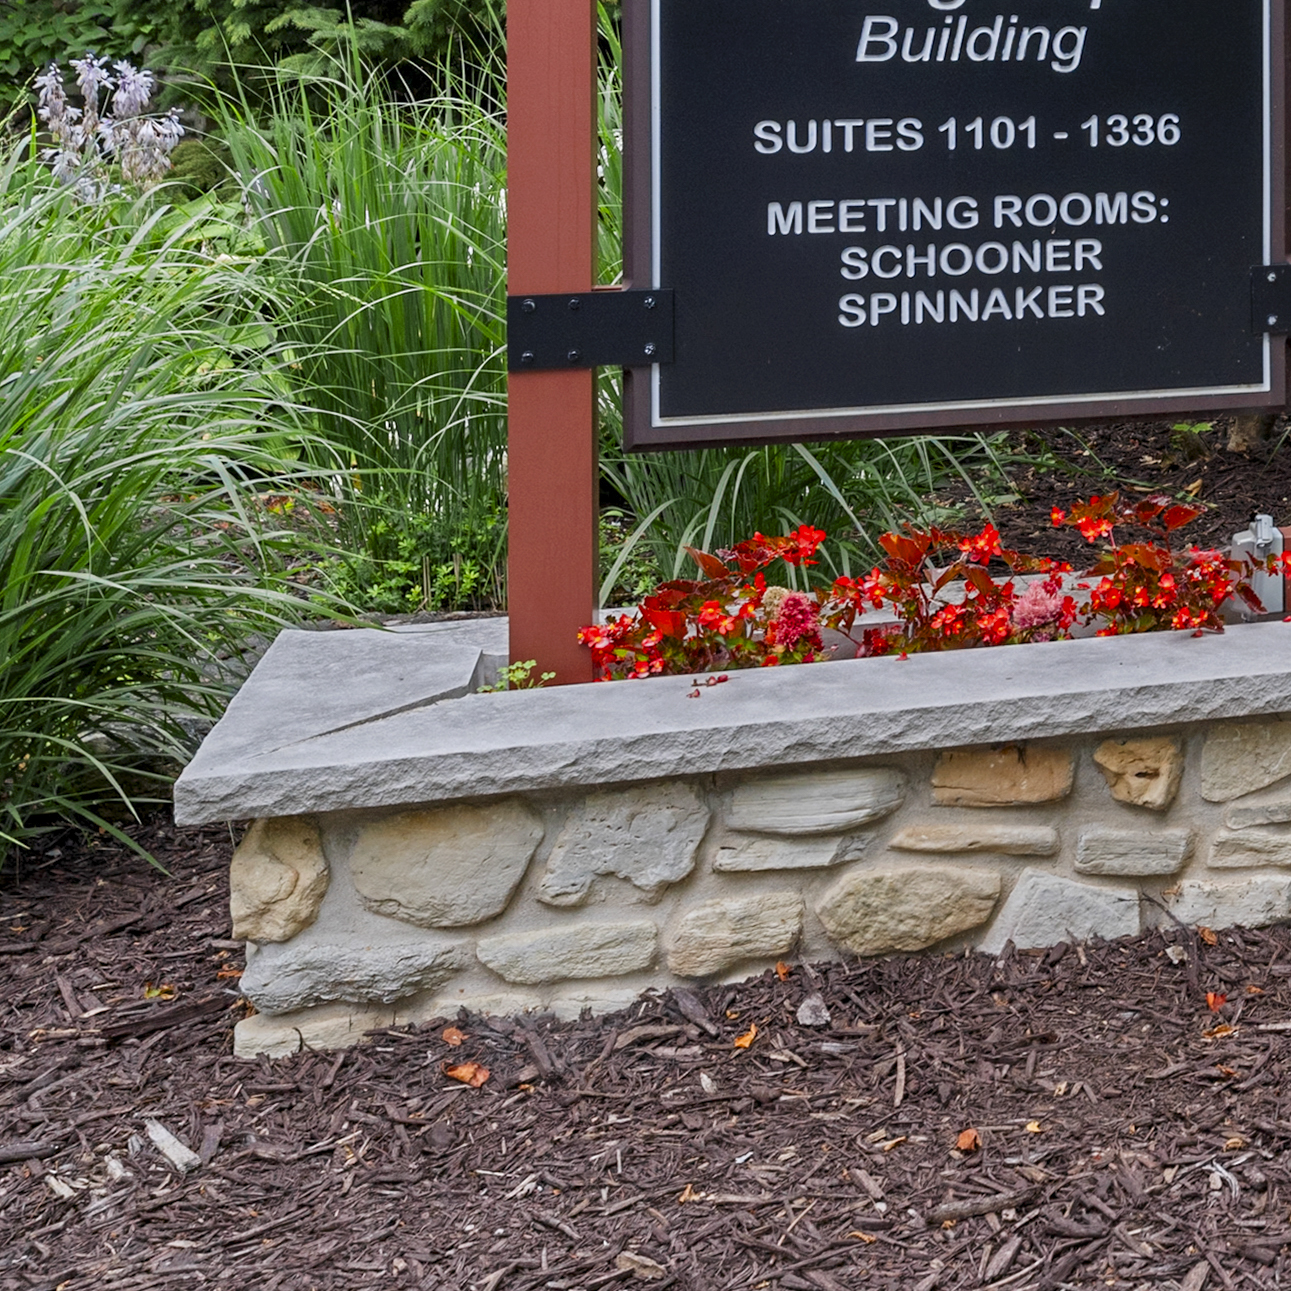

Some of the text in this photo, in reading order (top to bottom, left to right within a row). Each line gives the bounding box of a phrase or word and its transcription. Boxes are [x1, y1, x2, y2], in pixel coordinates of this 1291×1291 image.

[855, 14, 1088, 73] Building
[753, 113, 1181, 155] SUITES 1101 - 1336
[767, 191, 1169, 236] MEETING ROOMS:
[840, 238, 1103, 280] SCHOONER
[838, 283, 1106, 328] SPINNAKER
